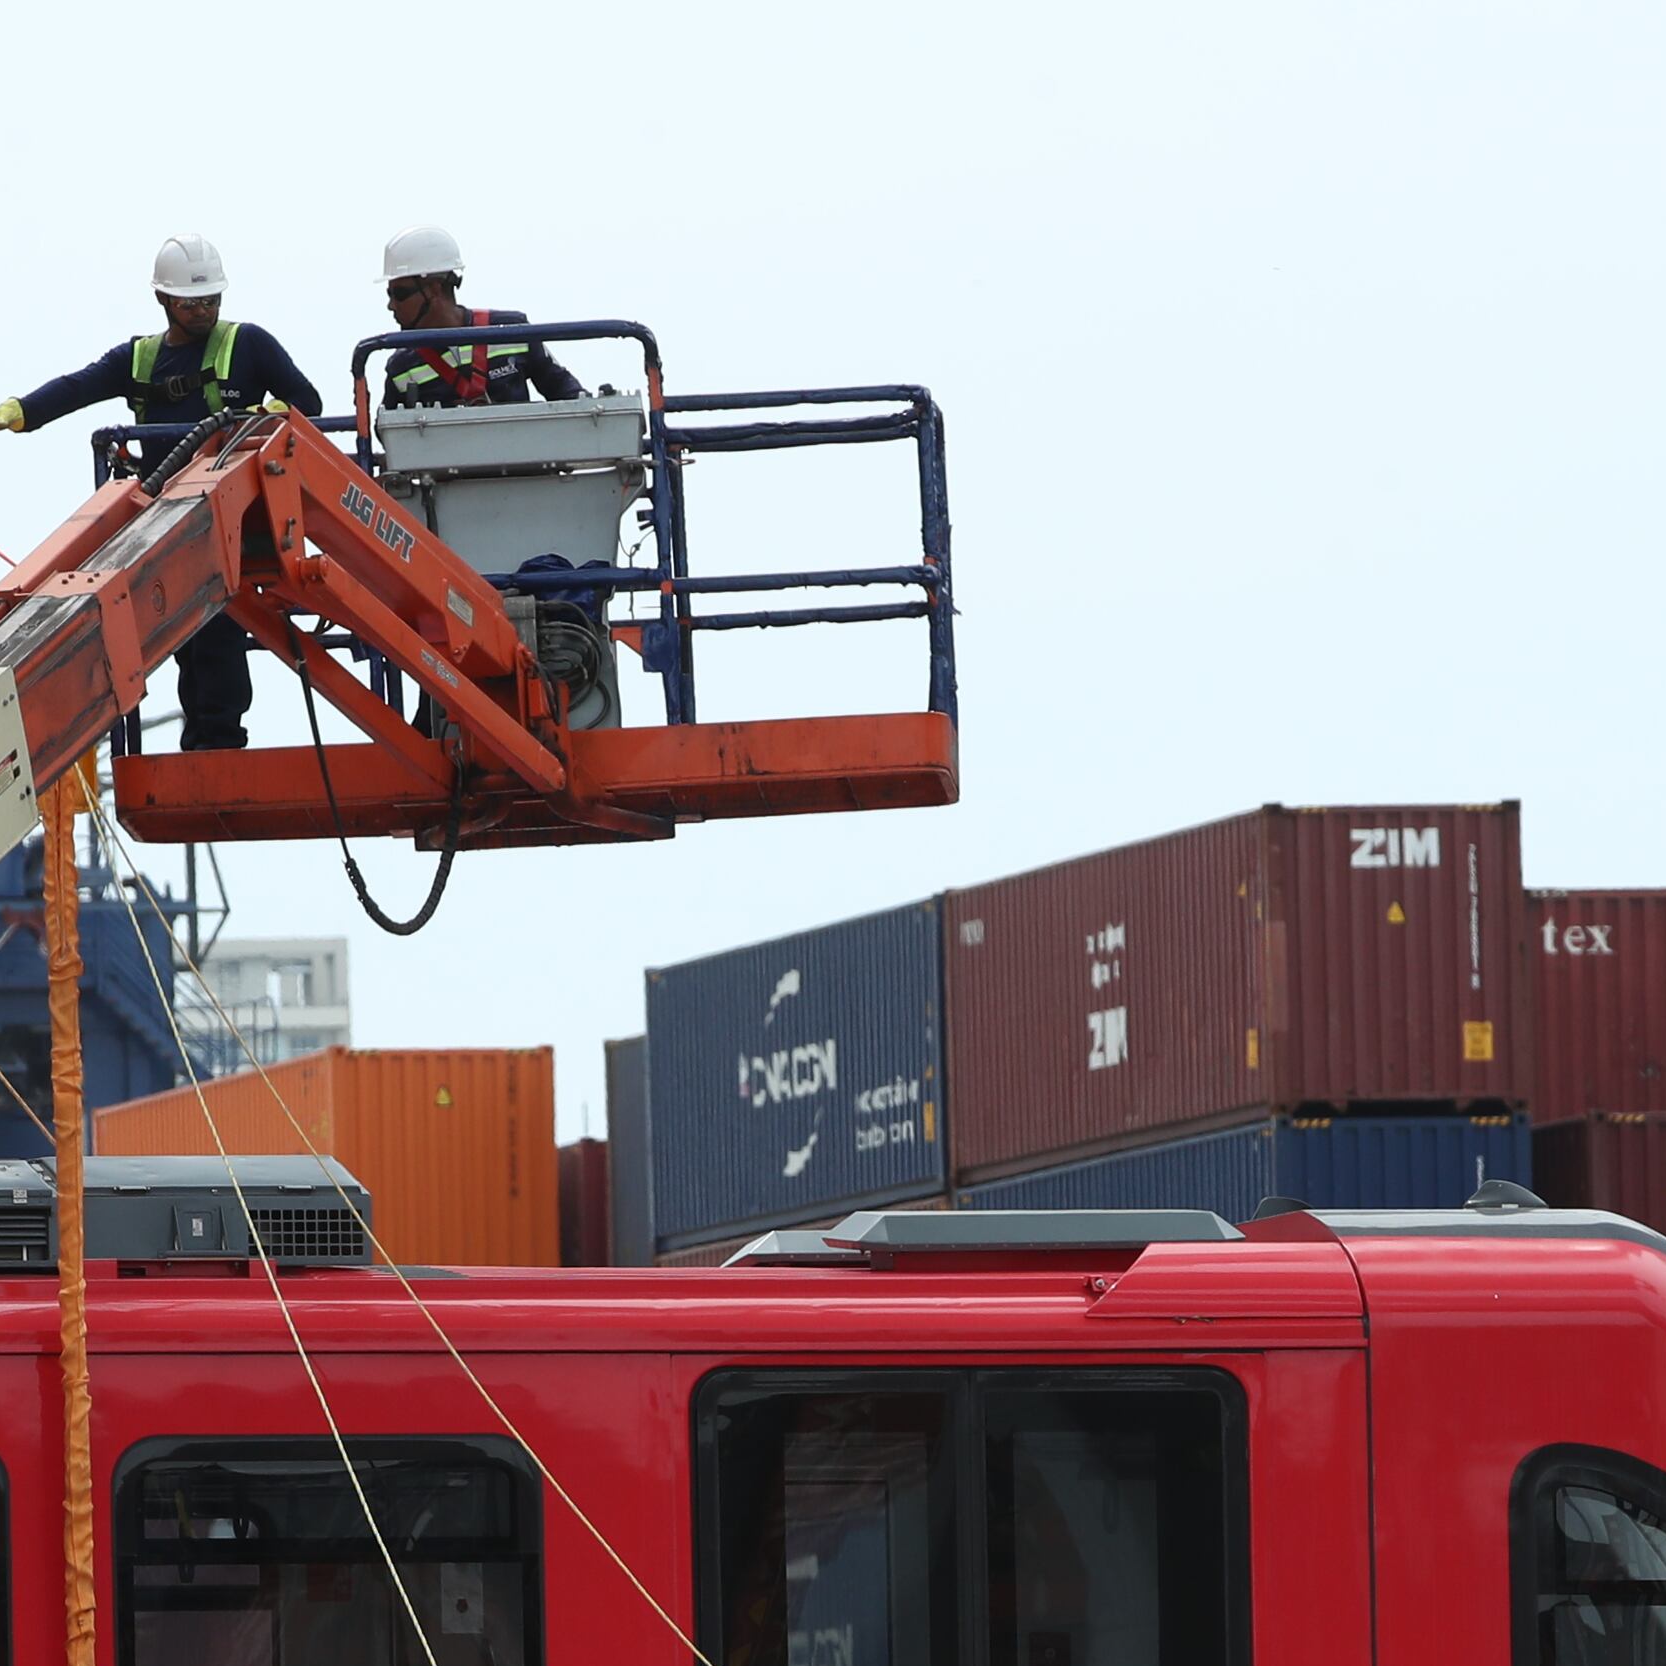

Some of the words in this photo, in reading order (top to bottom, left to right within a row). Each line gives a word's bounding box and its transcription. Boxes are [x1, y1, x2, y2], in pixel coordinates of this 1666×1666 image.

[340, 481, 375, 528] JLG
[374, 508, 415, 563] LIFT
[1349, 827, 1441, 868] ZIM
[1541, 916, 1614, 955] tex
